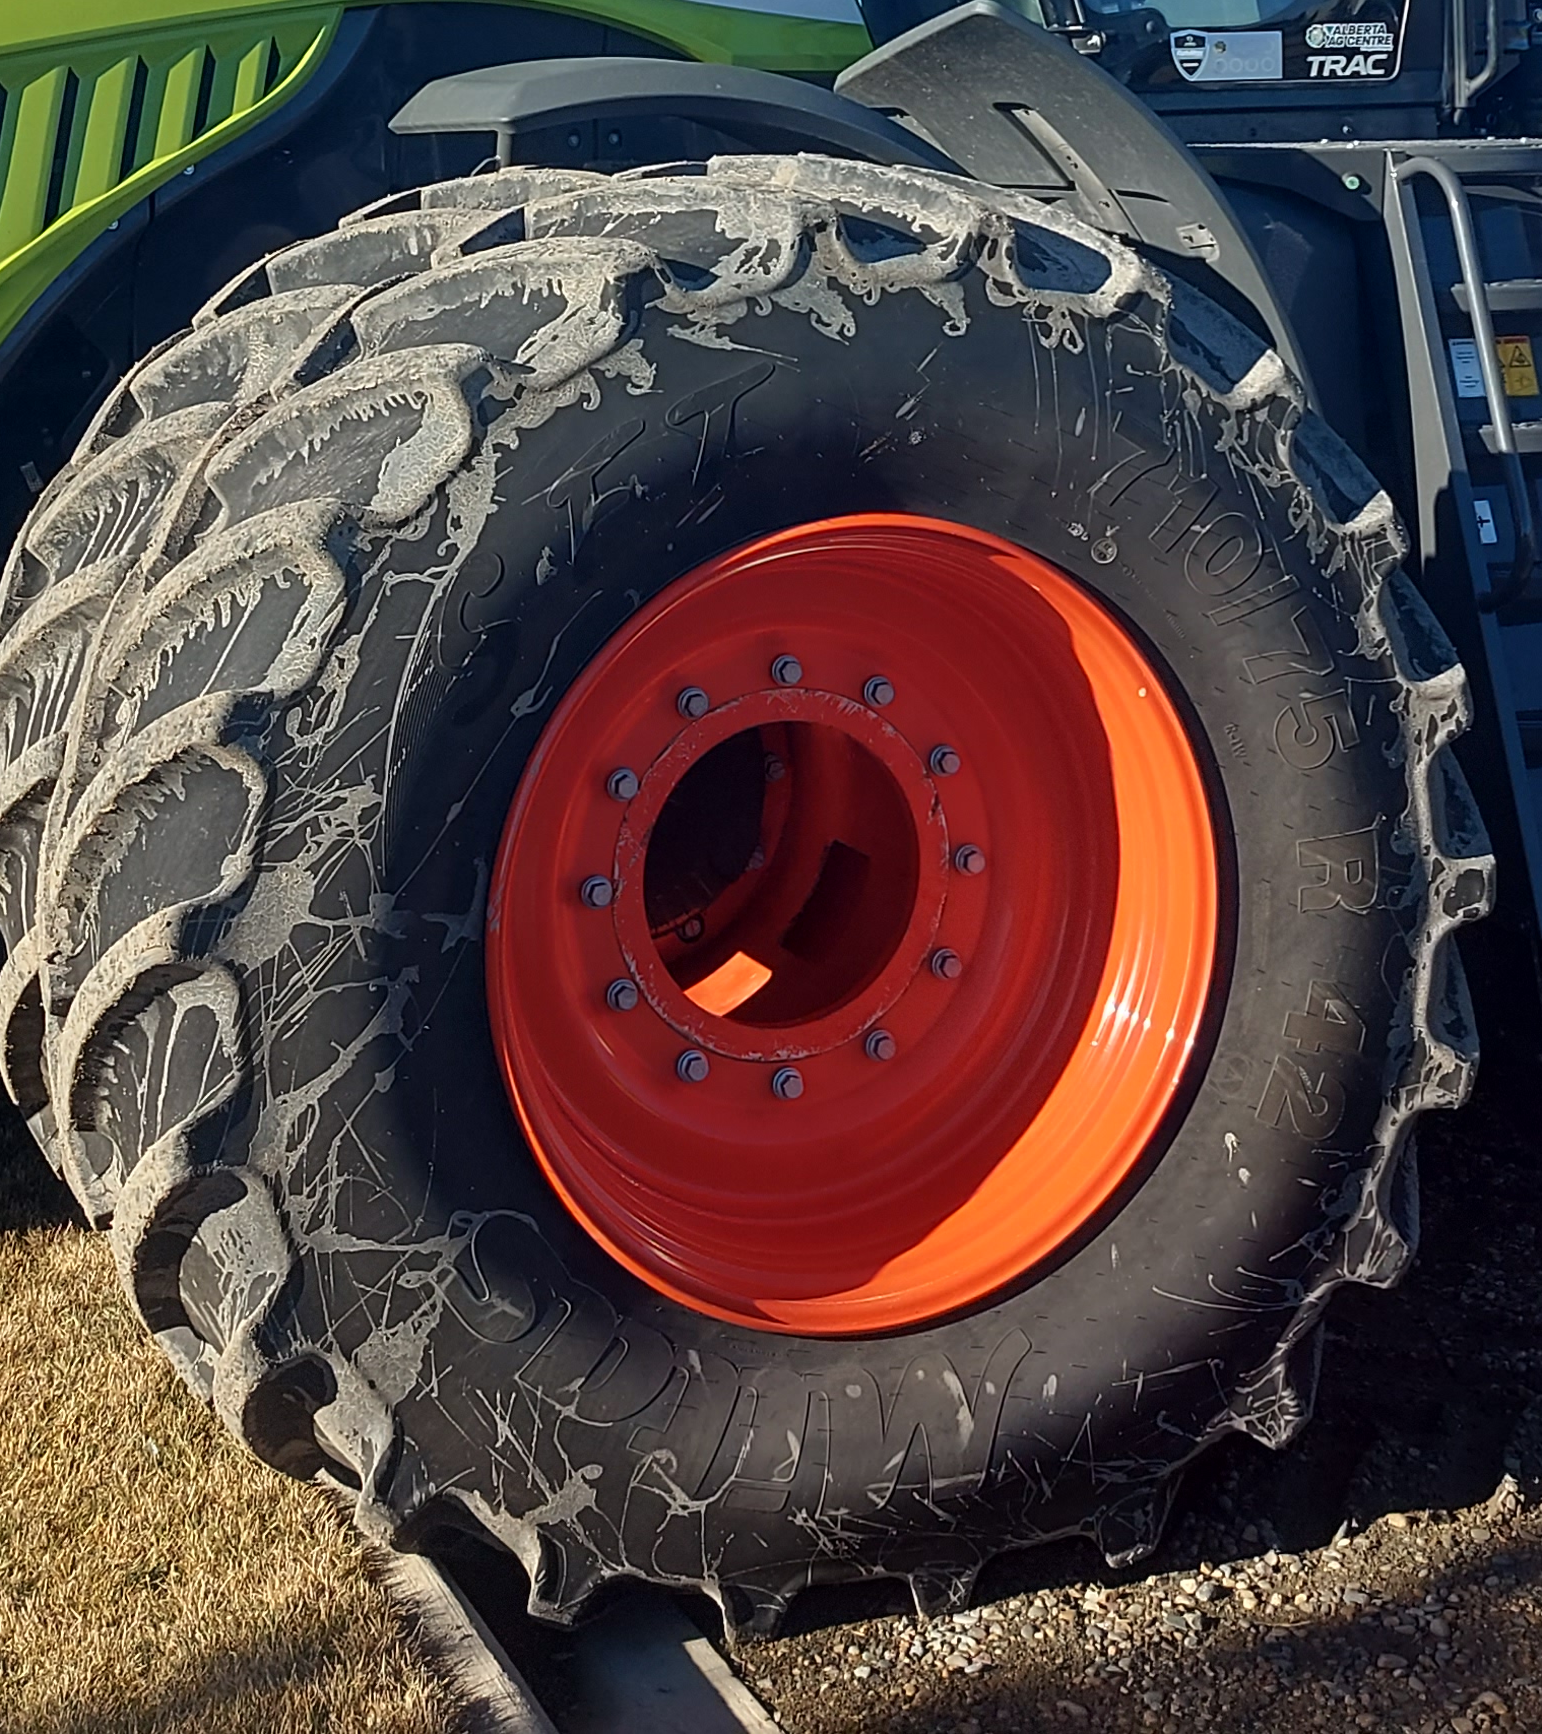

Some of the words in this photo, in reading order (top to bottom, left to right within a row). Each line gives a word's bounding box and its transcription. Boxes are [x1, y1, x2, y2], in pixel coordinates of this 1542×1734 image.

[1332, 24, 1387, 35] ALBERTA
[1347, 35, 1392, 46] CENTRE
[1306, 53, 1389, 78] TRAC
[1086, 424, 1360, 771] 710/75
[1297, 828, 1384, 915] R
[1256, 981, 1367, 1144] 42
